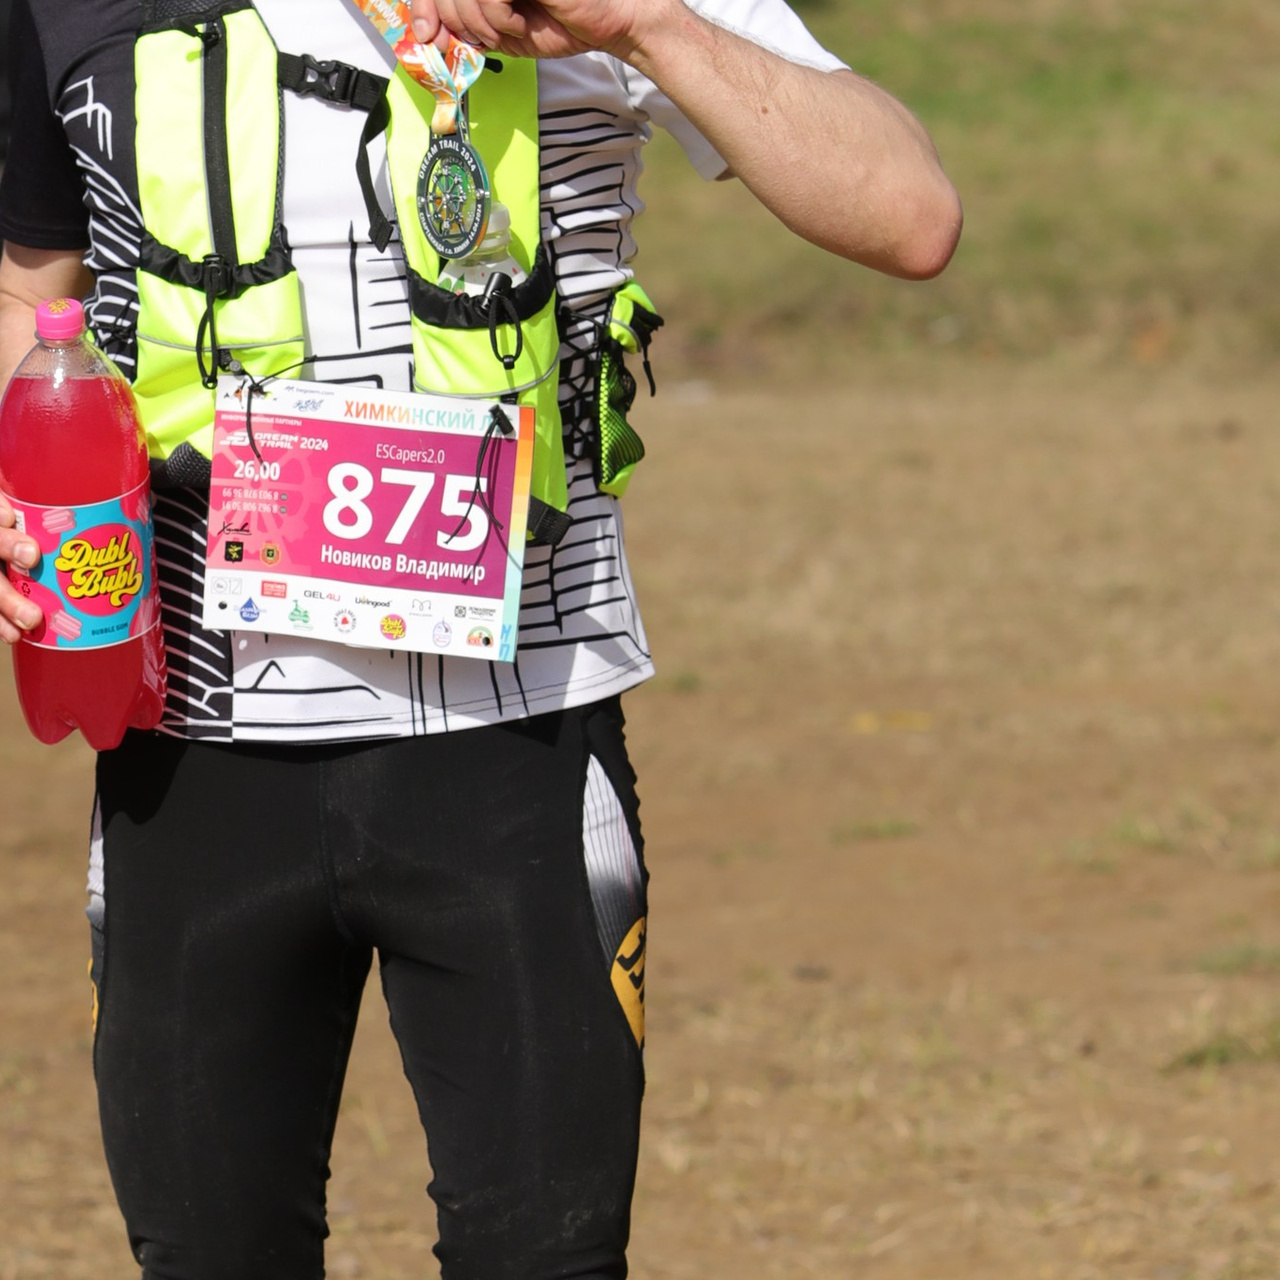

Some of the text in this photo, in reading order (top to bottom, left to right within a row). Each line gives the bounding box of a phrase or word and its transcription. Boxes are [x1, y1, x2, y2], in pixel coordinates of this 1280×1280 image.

[418, 139, 476, 179] DREAM TRAIL 2024
[344, 400, 474, 430] ХИМКИНСКИЙ
[254, 432, 329, 451] DREAM 2024
[260, 440, 294, 450] TRAIL
[376, 443, 445, 464] ESCapers2.0
[233, 459, 280, 482] 26,00
[323, 462, 489, 551] 875
[54, 531, 133, 571] Dubl
[321, 544, 485, 585] Новиков Владимир
[67, 558, 143, 607] Bubl
